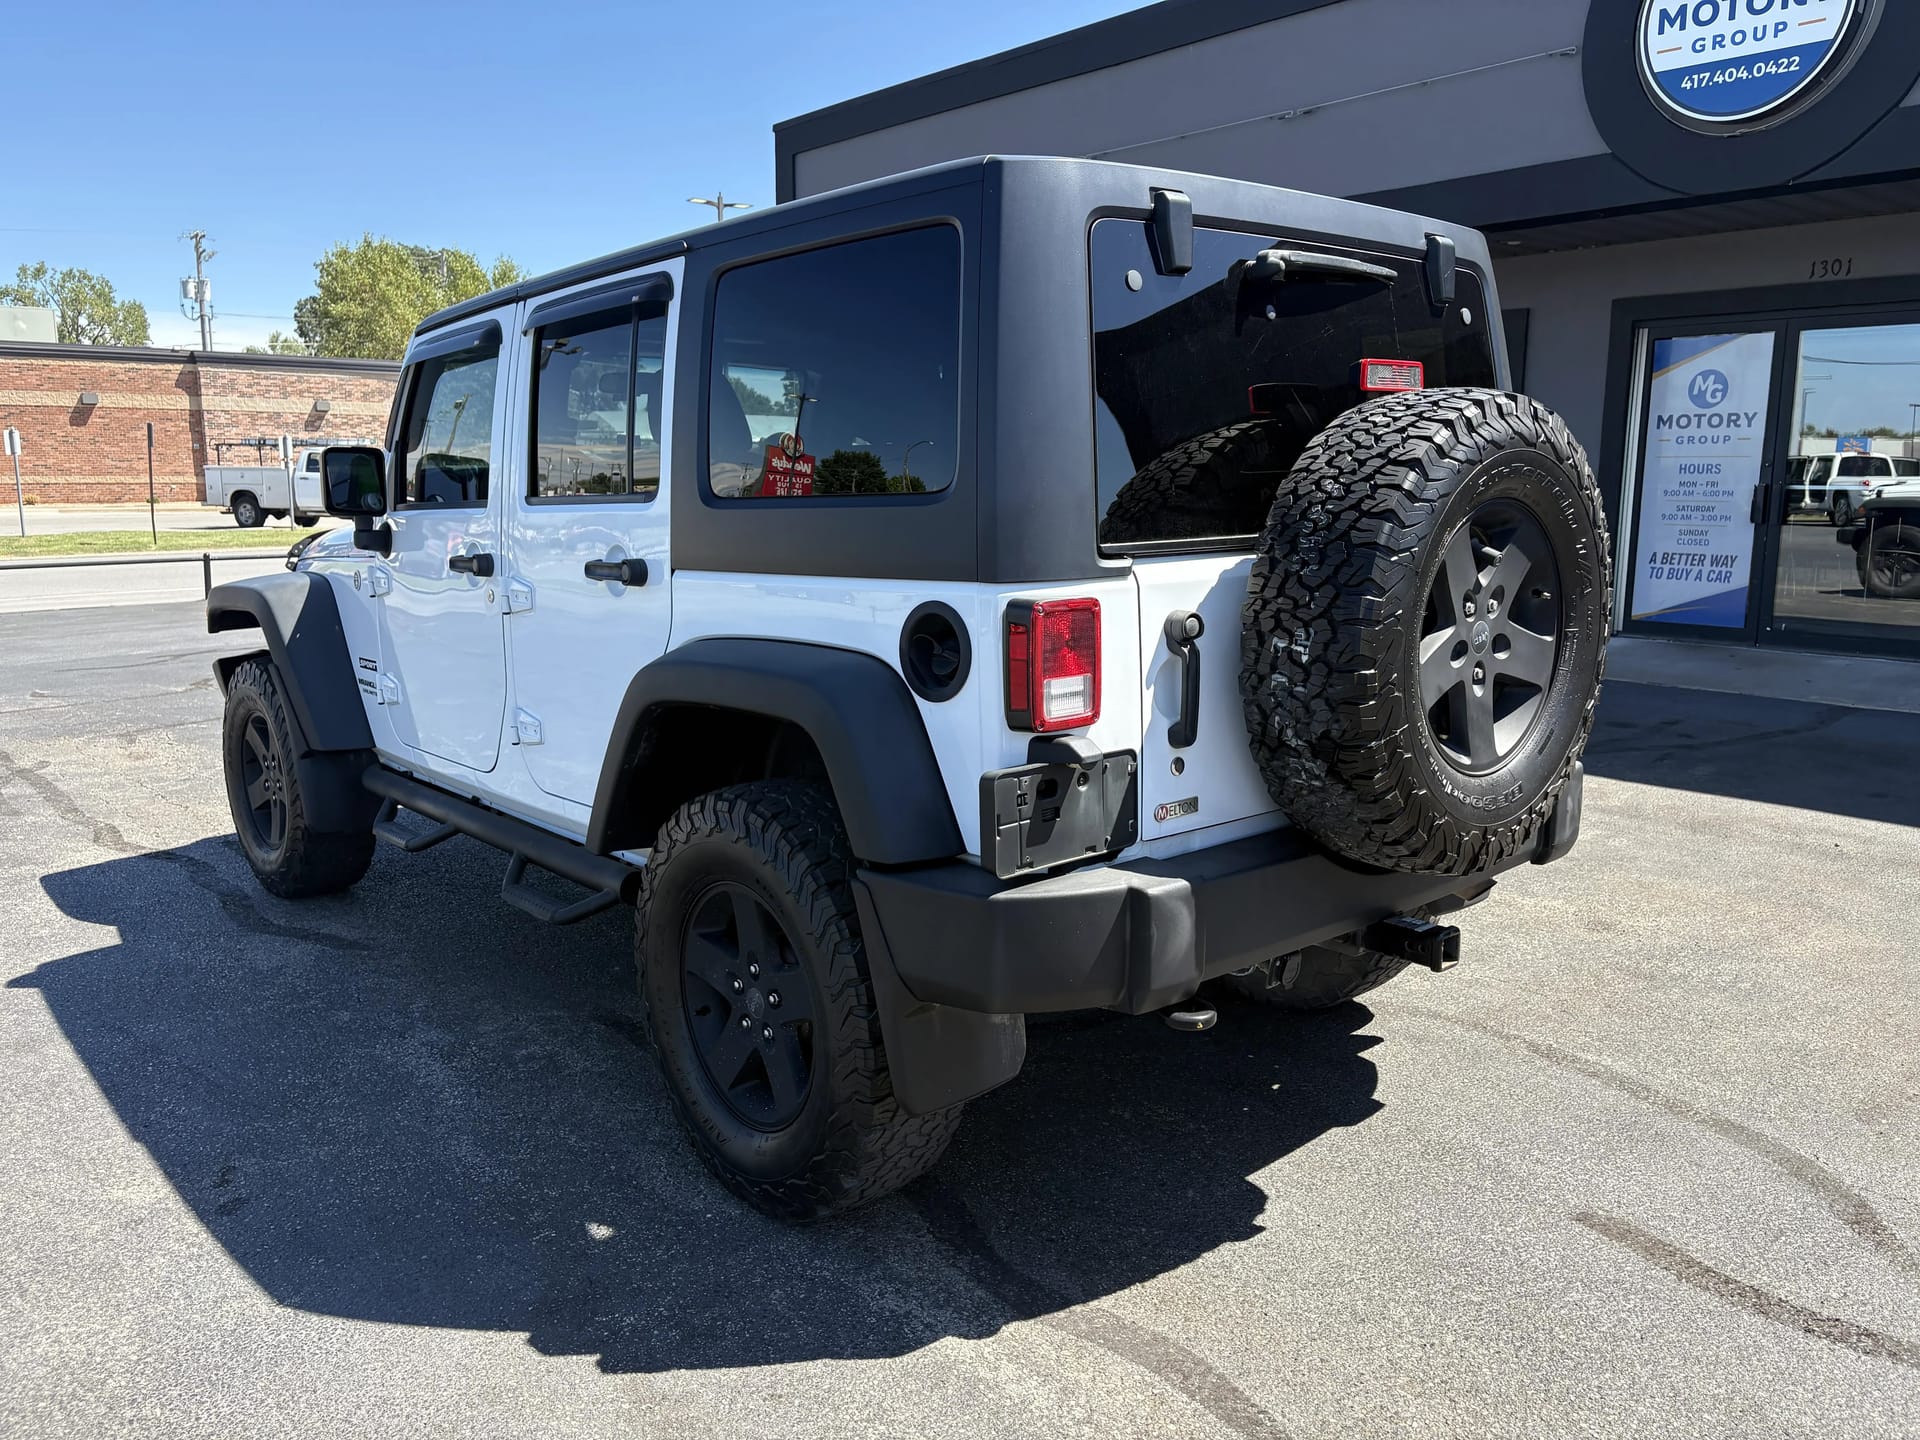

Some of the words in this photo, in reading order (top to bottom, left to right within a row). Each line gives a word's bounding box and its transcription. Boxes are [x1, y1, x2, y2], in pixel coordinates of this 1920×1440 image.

[1657, 0, 1827, 35] MOTO
[1691, 21, 1788, 53] GROUP
[1680, 55, 1800, 90] 417.404.0422
[1809, 257, 1852, 279] 1301
[1693, 374, 1723, 404] MG
[1656, 411, 1758, 430] MOTORY
[1675, 434, 1732, 445] GROUP
[1678, 463, 1722, 475] HOURS
[1663, 489, 1681, 497] 9:00
[1682, 489, 1695, 497] AM
[1702, 490, 1720, 498] 6:00
[1721, 490, 1735, 498] PM
[1678, 480, 1698, 489] MON
[1705, 481, 1719, 489] FRI
[1660, 513, 1679, 521] 9:00
[1719, 515, 1732, 523] PM
[1675, 505, 1717, 513] SATURDAY
[1676, 537, 1710, 546] CLOSED
[1678, 528, 1710, 537] SUNDAY
[1648, 551, 1658, 565] A
[1660, 552, 1707, 568] BETTER
[1710, 554, 1738, 569] WAY
[1649, 566, 1664, 580] TO
[1666, 567, 1693, 581] BUY
[1694, 568, 1702, 582] A
[1706, 569, 1733, 584] CAR
[1157, 800, 1196, 819] MELTON
